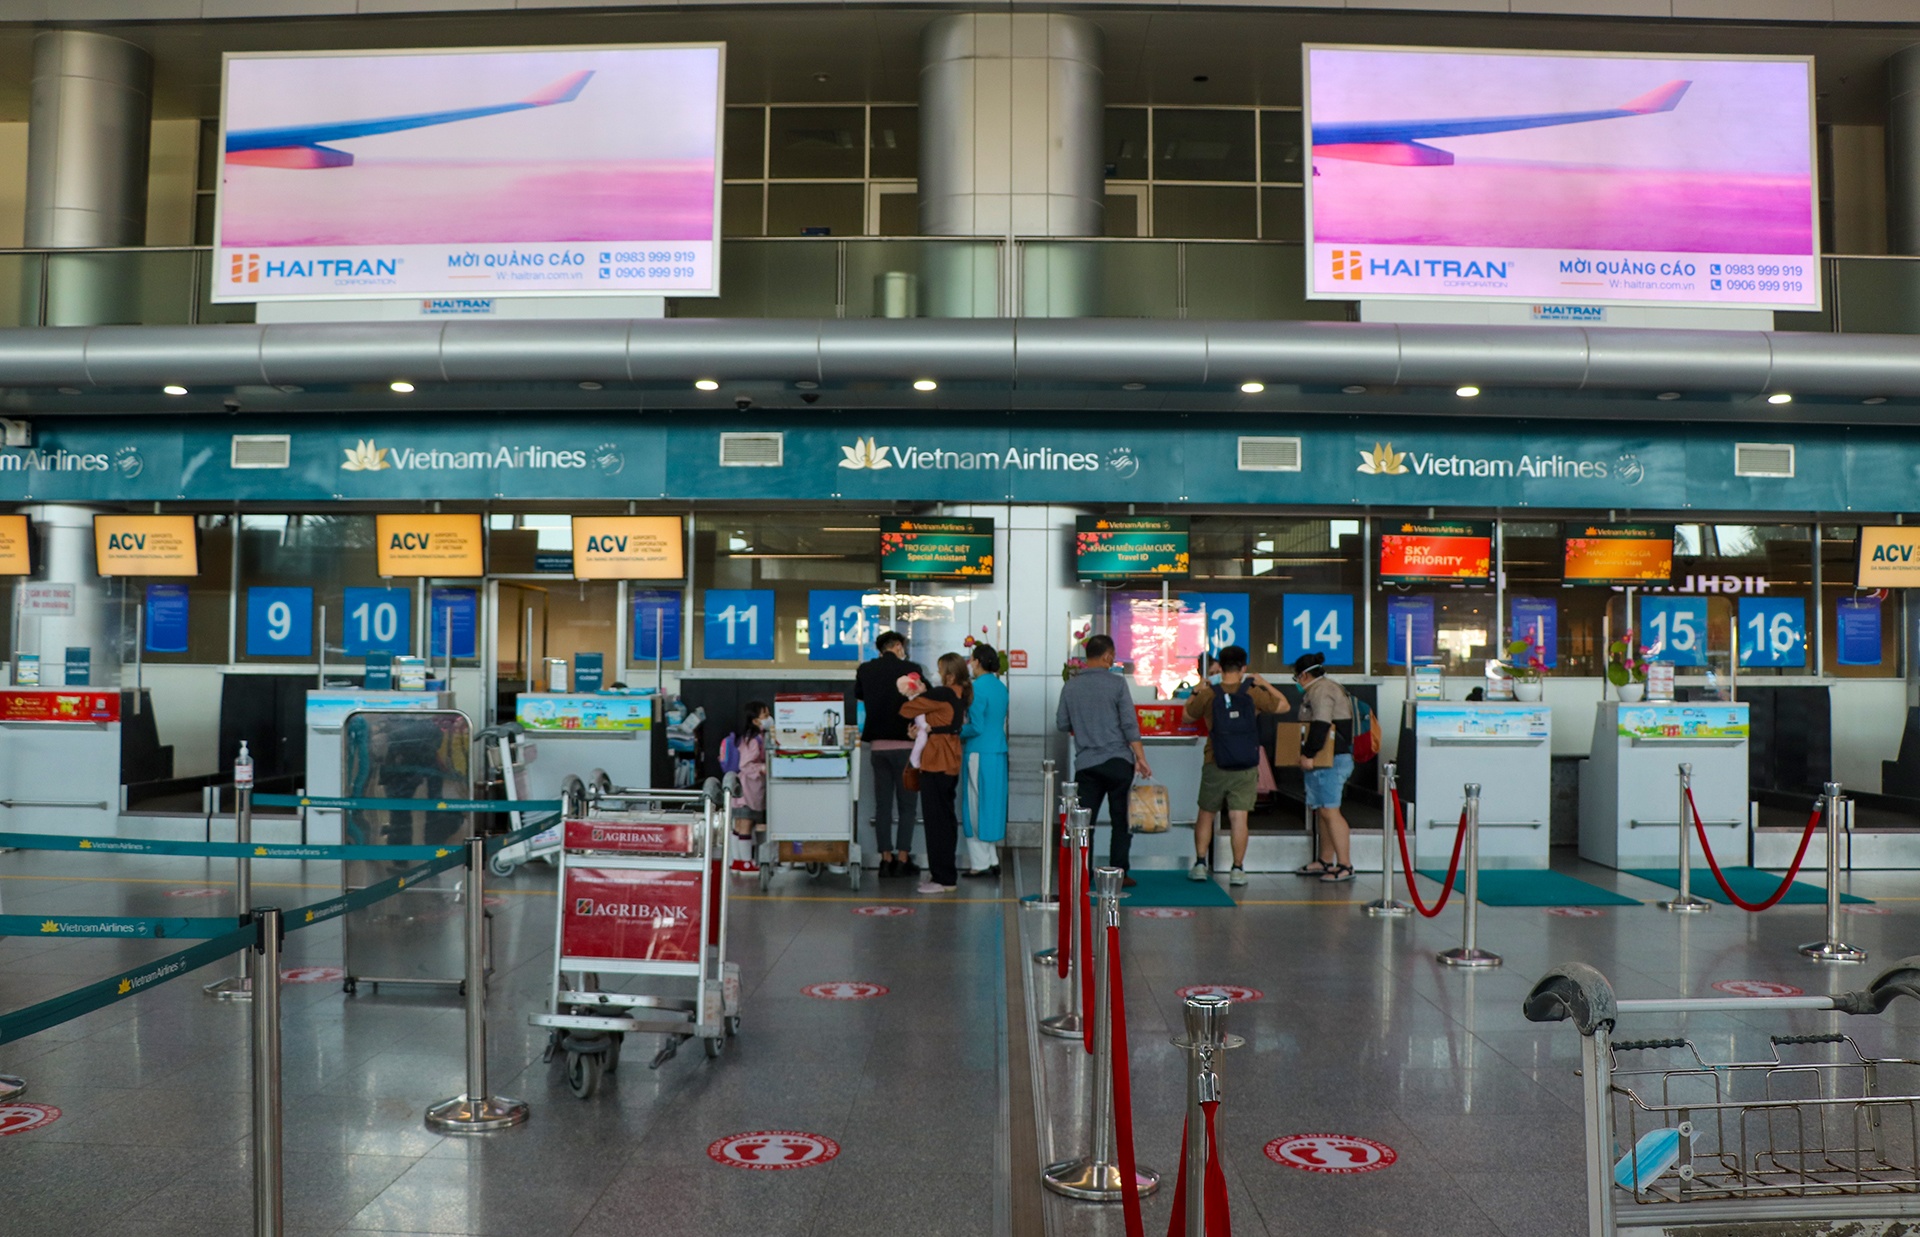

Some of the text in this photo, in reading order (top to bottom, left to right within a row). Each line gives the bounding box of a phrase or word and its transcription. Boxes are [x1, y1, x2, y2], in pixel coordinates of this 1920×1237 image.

[448, 250, 585, 268] MỜI QUẢNG CÁO
[615, 251, 695, 263] 0983 999 919
[511, 270, 583, 280] haitran.com.vn
[615, 267, 695, 278] 0906 999 919
[1559, 258, 1696, 276] MỜI QUẢNG CÁO
[1725, 264, 1803, 276] 0983 999 919
[1444, 280, 1508, 288] CORPORATION
[1624, 280, 1695, 290] haitran.com.vn
[1727, 280, 1803, 292] 0906 999 919
[22, 449, 109, 471] Airlines
[108, 534, 146, 550] ACV
[390, 533, 429, 550] ACV
[586, 535, 628, 552] ACV
[907, 553, 966, 562] Special Assistant
[1405, 546, 1430, 555] SKY
[1872, 544, 1914, 562] ACV
[1404, 556, 1462, 566] PRIORITY
[268, 601, 291, 640] 9
[353, 602, 397, 641] 10
[718, 605, 758, 644] 11
[820, 605, 869, 645] 12
[1293, 610, 1342, 649] 14
[1650, 611, 1696, 650] 15
[1748, 612, 1794, 651] 16
[604, 832, 663, 843] AGRIBANK
[594, 903, 688, 919] AGRIBANK
[722, 1159, 774, 1170] STAND
[1296, 1164, 1352, 1173] STAND
